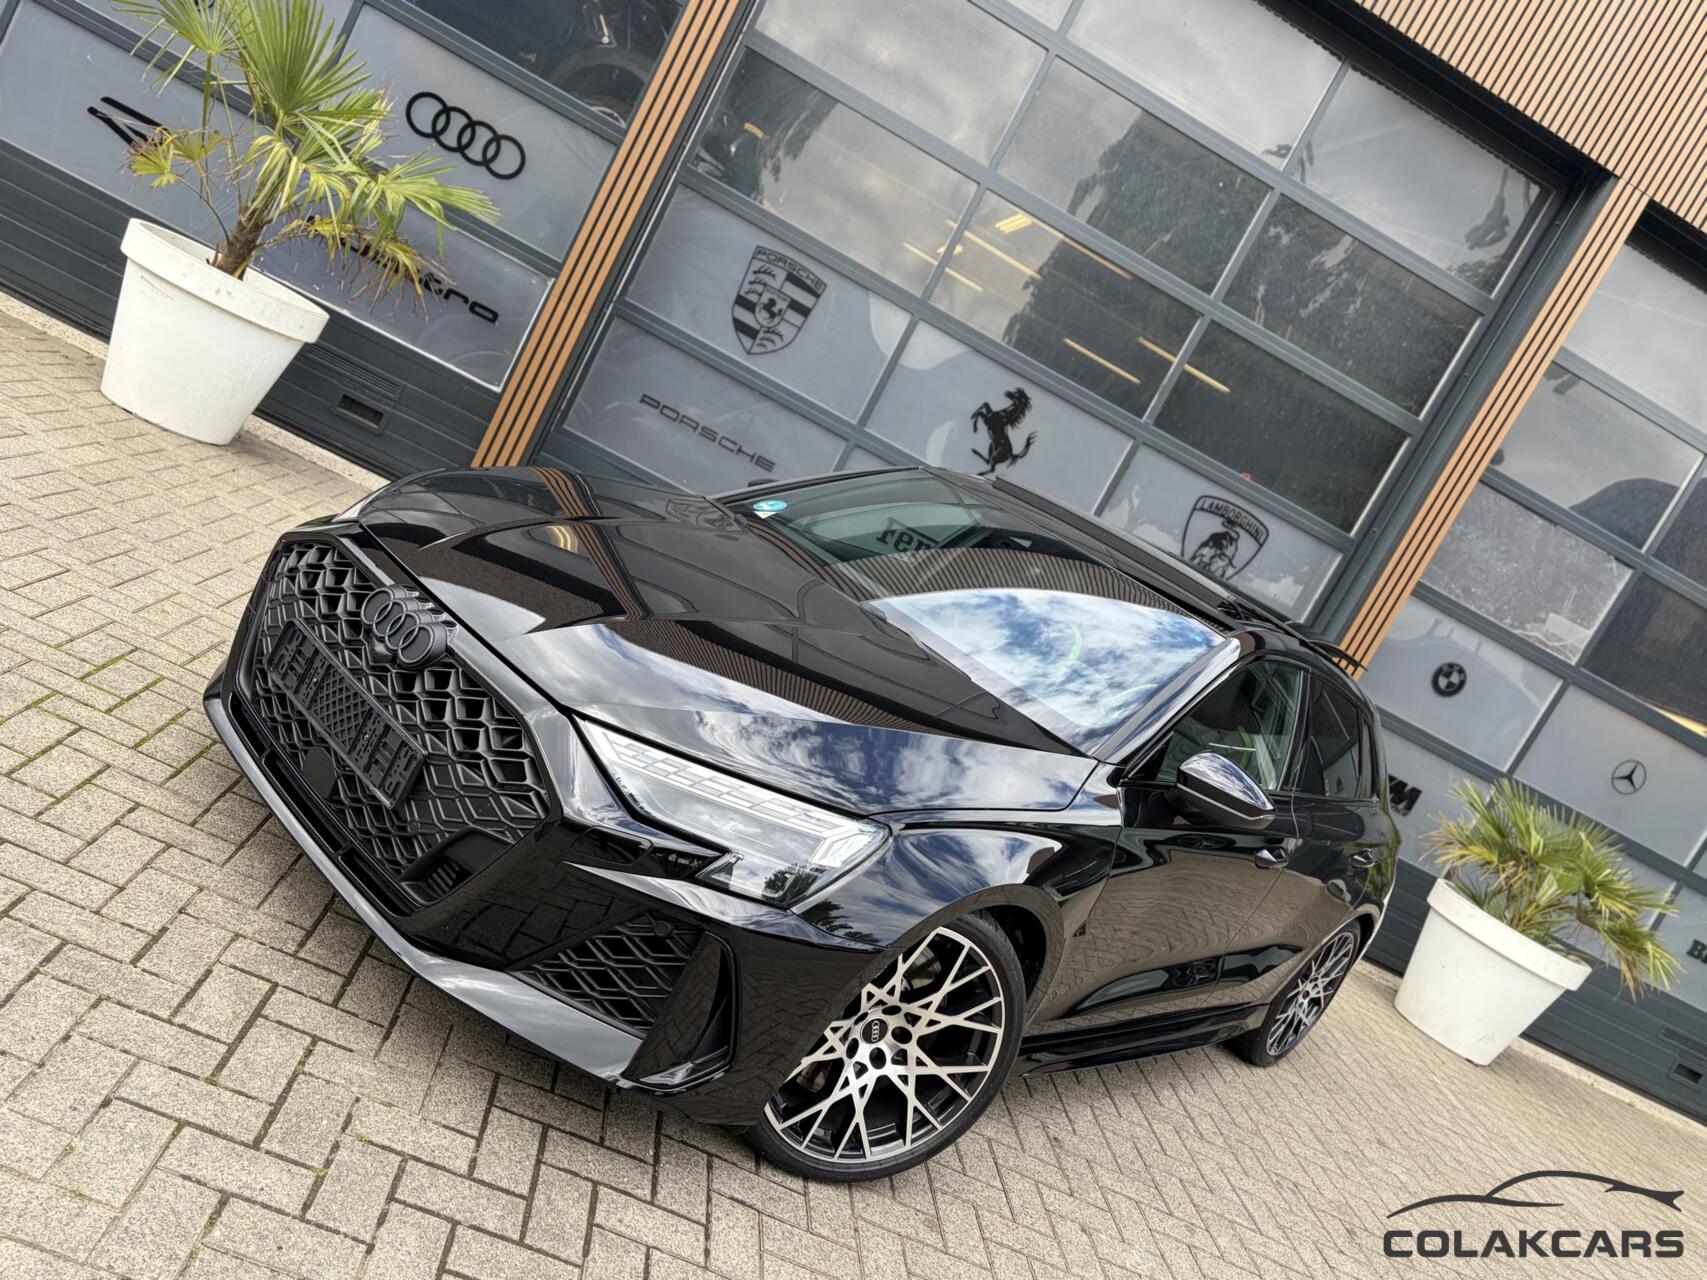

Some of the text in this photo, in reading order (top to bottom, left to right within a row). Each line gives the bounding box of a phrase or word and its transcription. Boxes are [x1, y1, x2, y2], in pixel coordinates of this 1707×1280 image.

[756, 248, 823, 292] PORSCHE
[639, 393, 776, 473] PORSCHE
[1200, 499, 1265, 540] LAMBORGHINI
